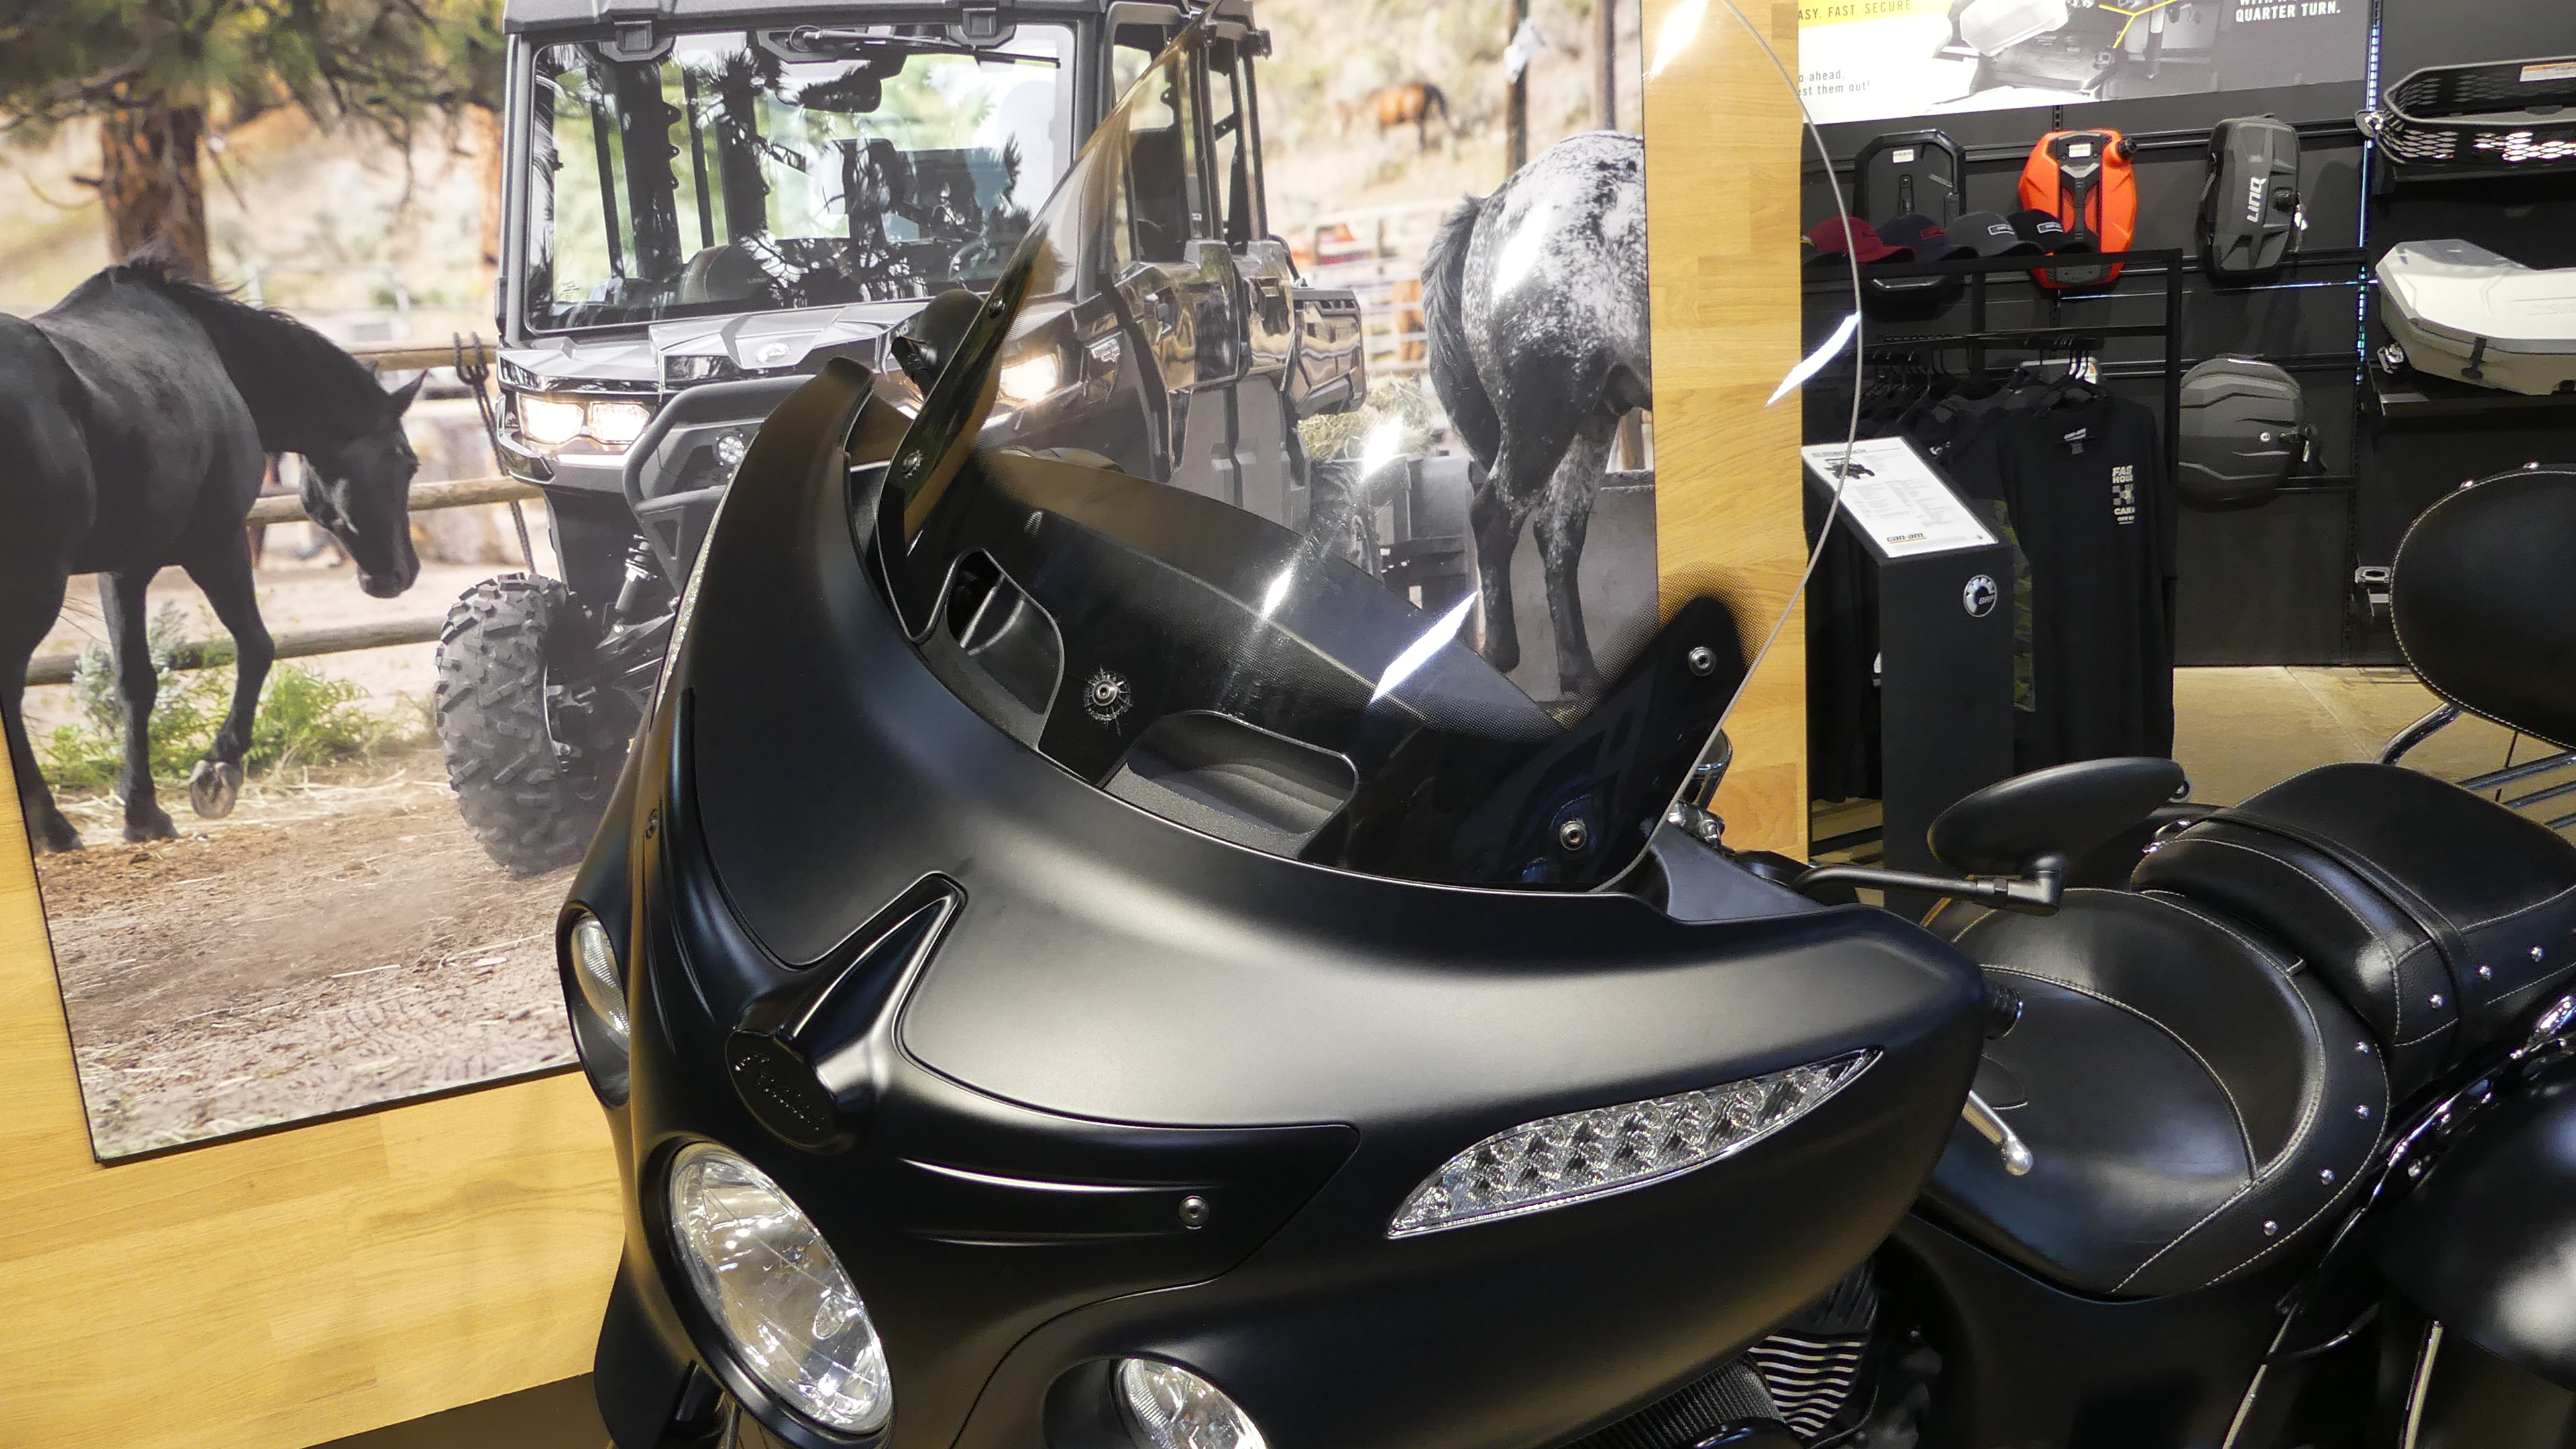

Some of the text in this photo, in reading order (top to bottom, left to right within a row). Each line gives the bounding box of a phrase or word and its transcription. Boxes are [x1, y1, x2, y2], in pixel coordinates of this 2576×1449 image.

[2235, 1, 2341, 23] QUARTER TURN.
[1817, 85, 1843, 95] them
[1849, 80, 1870, 92] out!
